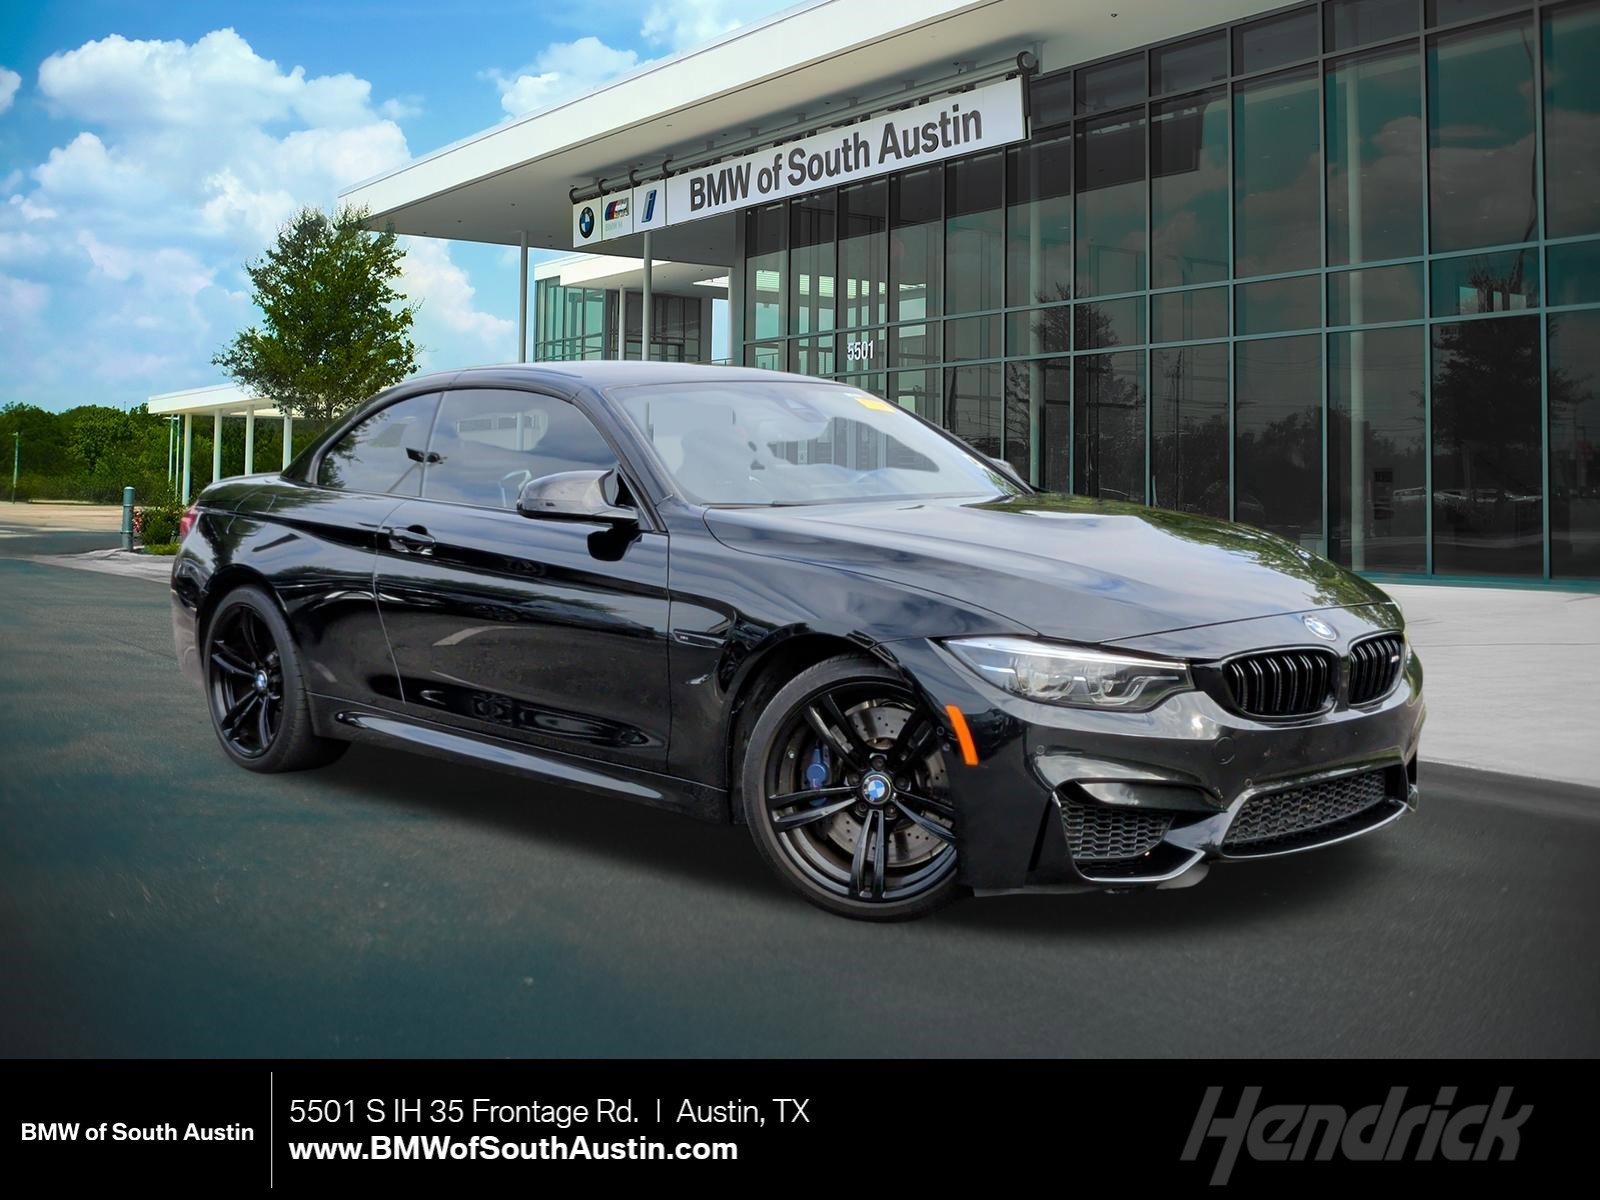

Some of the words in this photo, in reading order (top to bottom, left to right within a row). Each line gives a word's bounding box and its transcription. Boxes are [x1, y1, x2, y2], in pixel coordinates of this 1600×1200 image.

[690, 162, 750, 211] BMW
[757, 153, 782, 194] of
[787, 132, 870, 186] South
[878, 104, 982, 164] Austin
[847, 340, 874, 361] 5501
